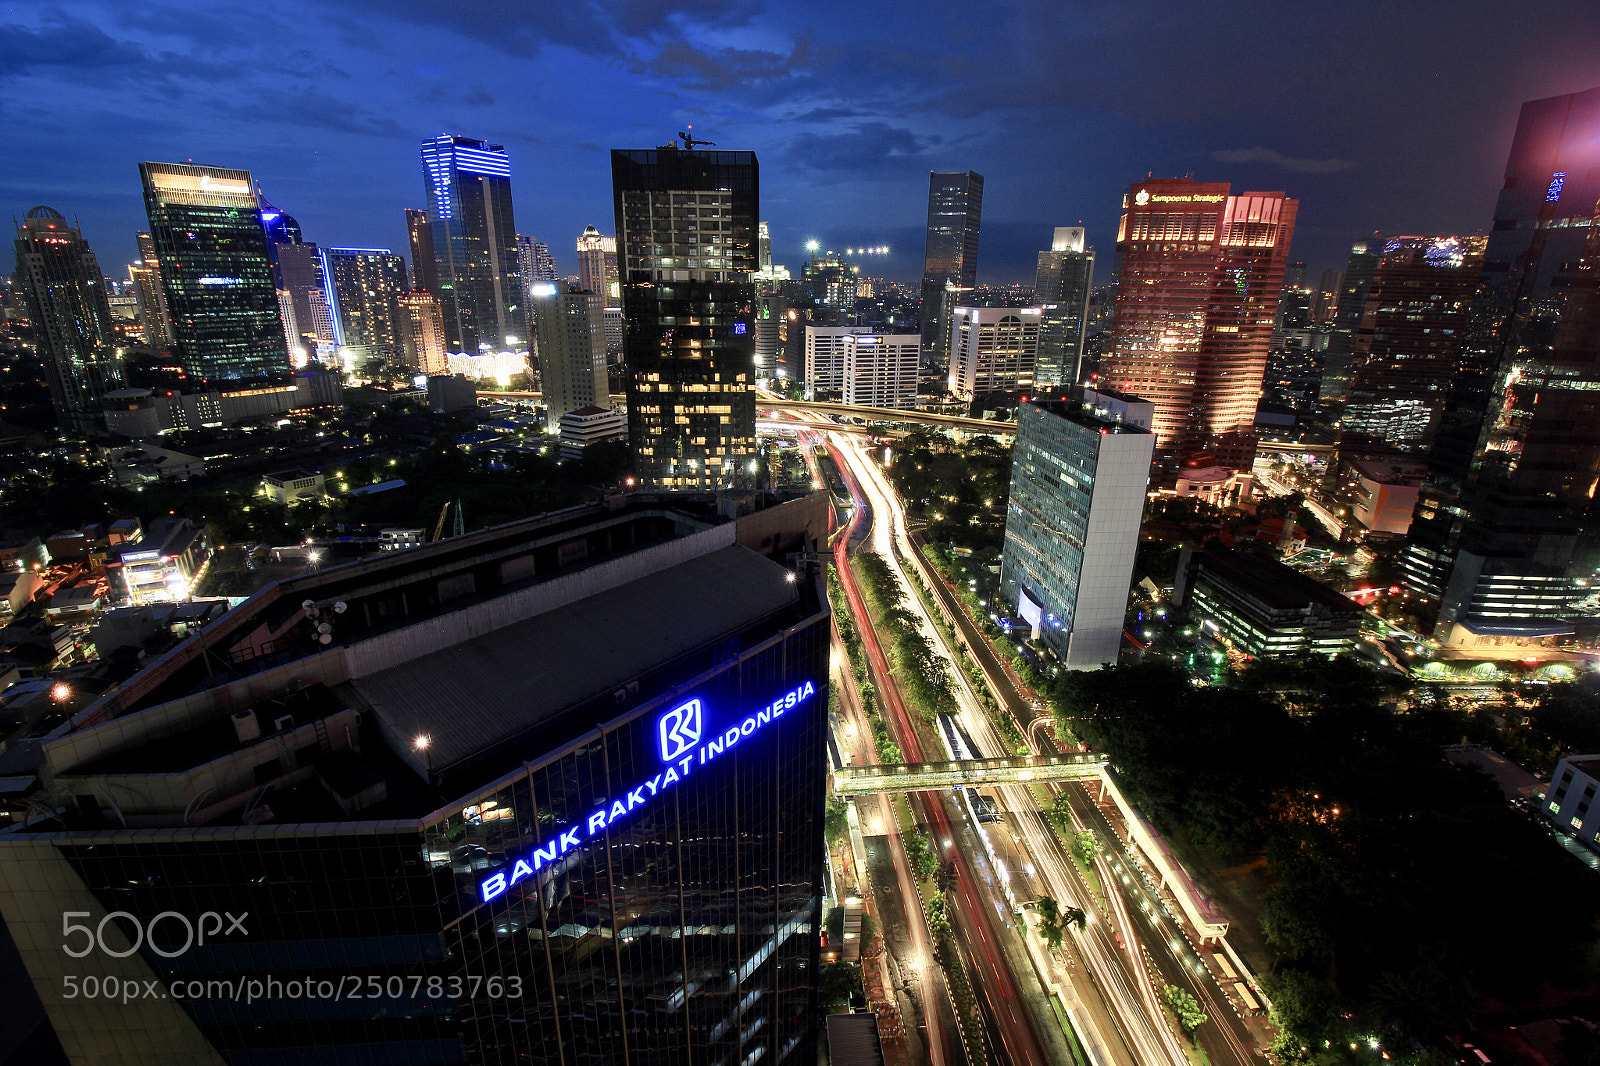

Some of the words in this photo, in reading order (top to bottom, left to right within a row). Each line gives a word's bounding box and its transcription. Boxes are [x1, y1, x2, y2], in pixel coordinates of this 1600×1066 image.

[1151, 194, 1192, 203] Sampoerna
[1192, 194, 1225, 204] Strategic
[480, 825, 582, 903] BANK
[587, 754, 694, 836] RAKYAT
[699, 680, 816, 766] INDONESIA
